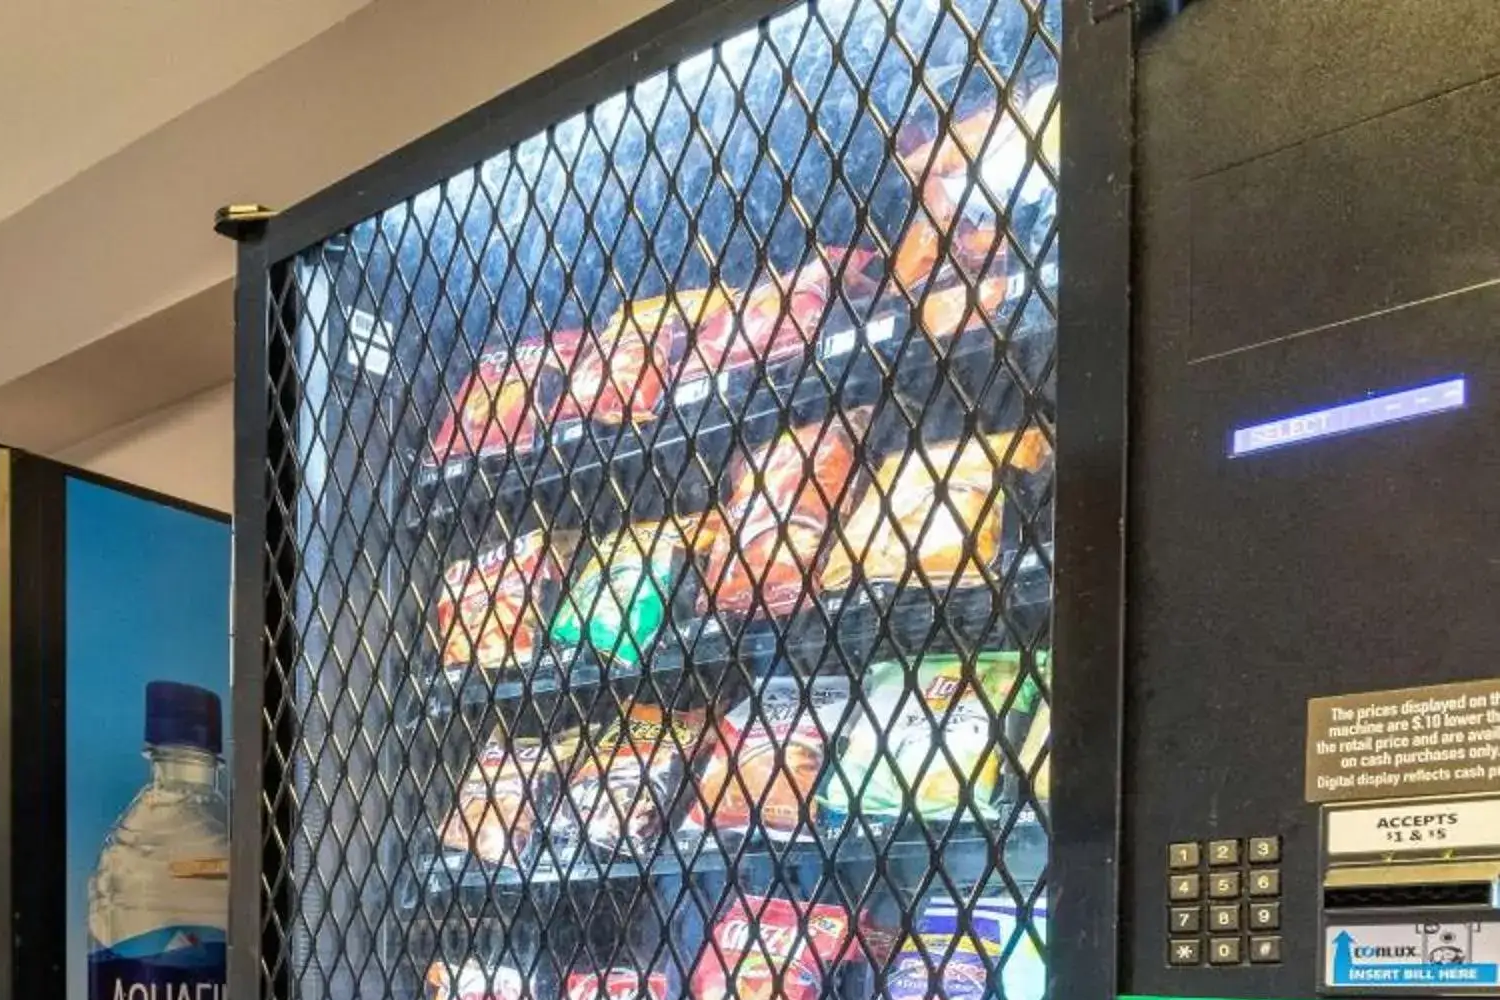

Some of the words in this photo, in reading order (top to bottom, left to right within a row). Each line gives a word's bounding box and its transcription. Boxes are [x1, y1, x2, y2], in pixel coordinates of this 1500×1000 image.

[1331, 706, 1354, 721] The
[1357, 704, 1398, 725] prices
[1401, 694, 1466, 716] displayed
[1469, 696, 1487, 708] on
[1329, 720, 1384, 738] machine
[1387, 719, 1409, 733] are
[1411, 713, 1440, 731] $.10
[1444, 712, 1482, 728] lower
[1486, 708, 1500, 723] th
[1316, 740, 1337, 754] the
[1339, 736, 1373, 753] retail
[1375, 735, 1409, 752] price
[1412, 731, 1438, 747] and
[1442, 731, 1465, 744] are
[1341, 757, 1357, 768] on
[1360, 752, 1392, 767] cash
[1395, 748, 1466, 767] purchases
[1317, 773, 1355, 790] Digital
[1357, 772, 1400, 788] display
[1403, 767, 1451, 783] reflects
[1454, 764, 1485, 779] cash
[1376, 813, 1459, 829] ACCEPTS
[1387, 830, 1404, 842] $1
[1409, 829, 1423, 841] &
[1430, 828, 1448, 840] $5
[1180, 849, 1188, 862] 1
[1217, 845, 1229, 859] 2
[1258, 842, 1269, 856] 3
[1179, 881, 1189, 894] 4
[1218, 879, 1229, 892] 5
[1258, 875, 1269, 889] 6
[1179, 913, 1190, 927] 7
[1219, 911, 1229, 925] 8
[1258, 909, 1270, 923] 9
[1219, 944, 1230, 957] 0
[1349, 968, 1401, 980] INSERT
[1404, 968, 1435, 980] BILL
[1439, 968, 1478, 980] HERE
